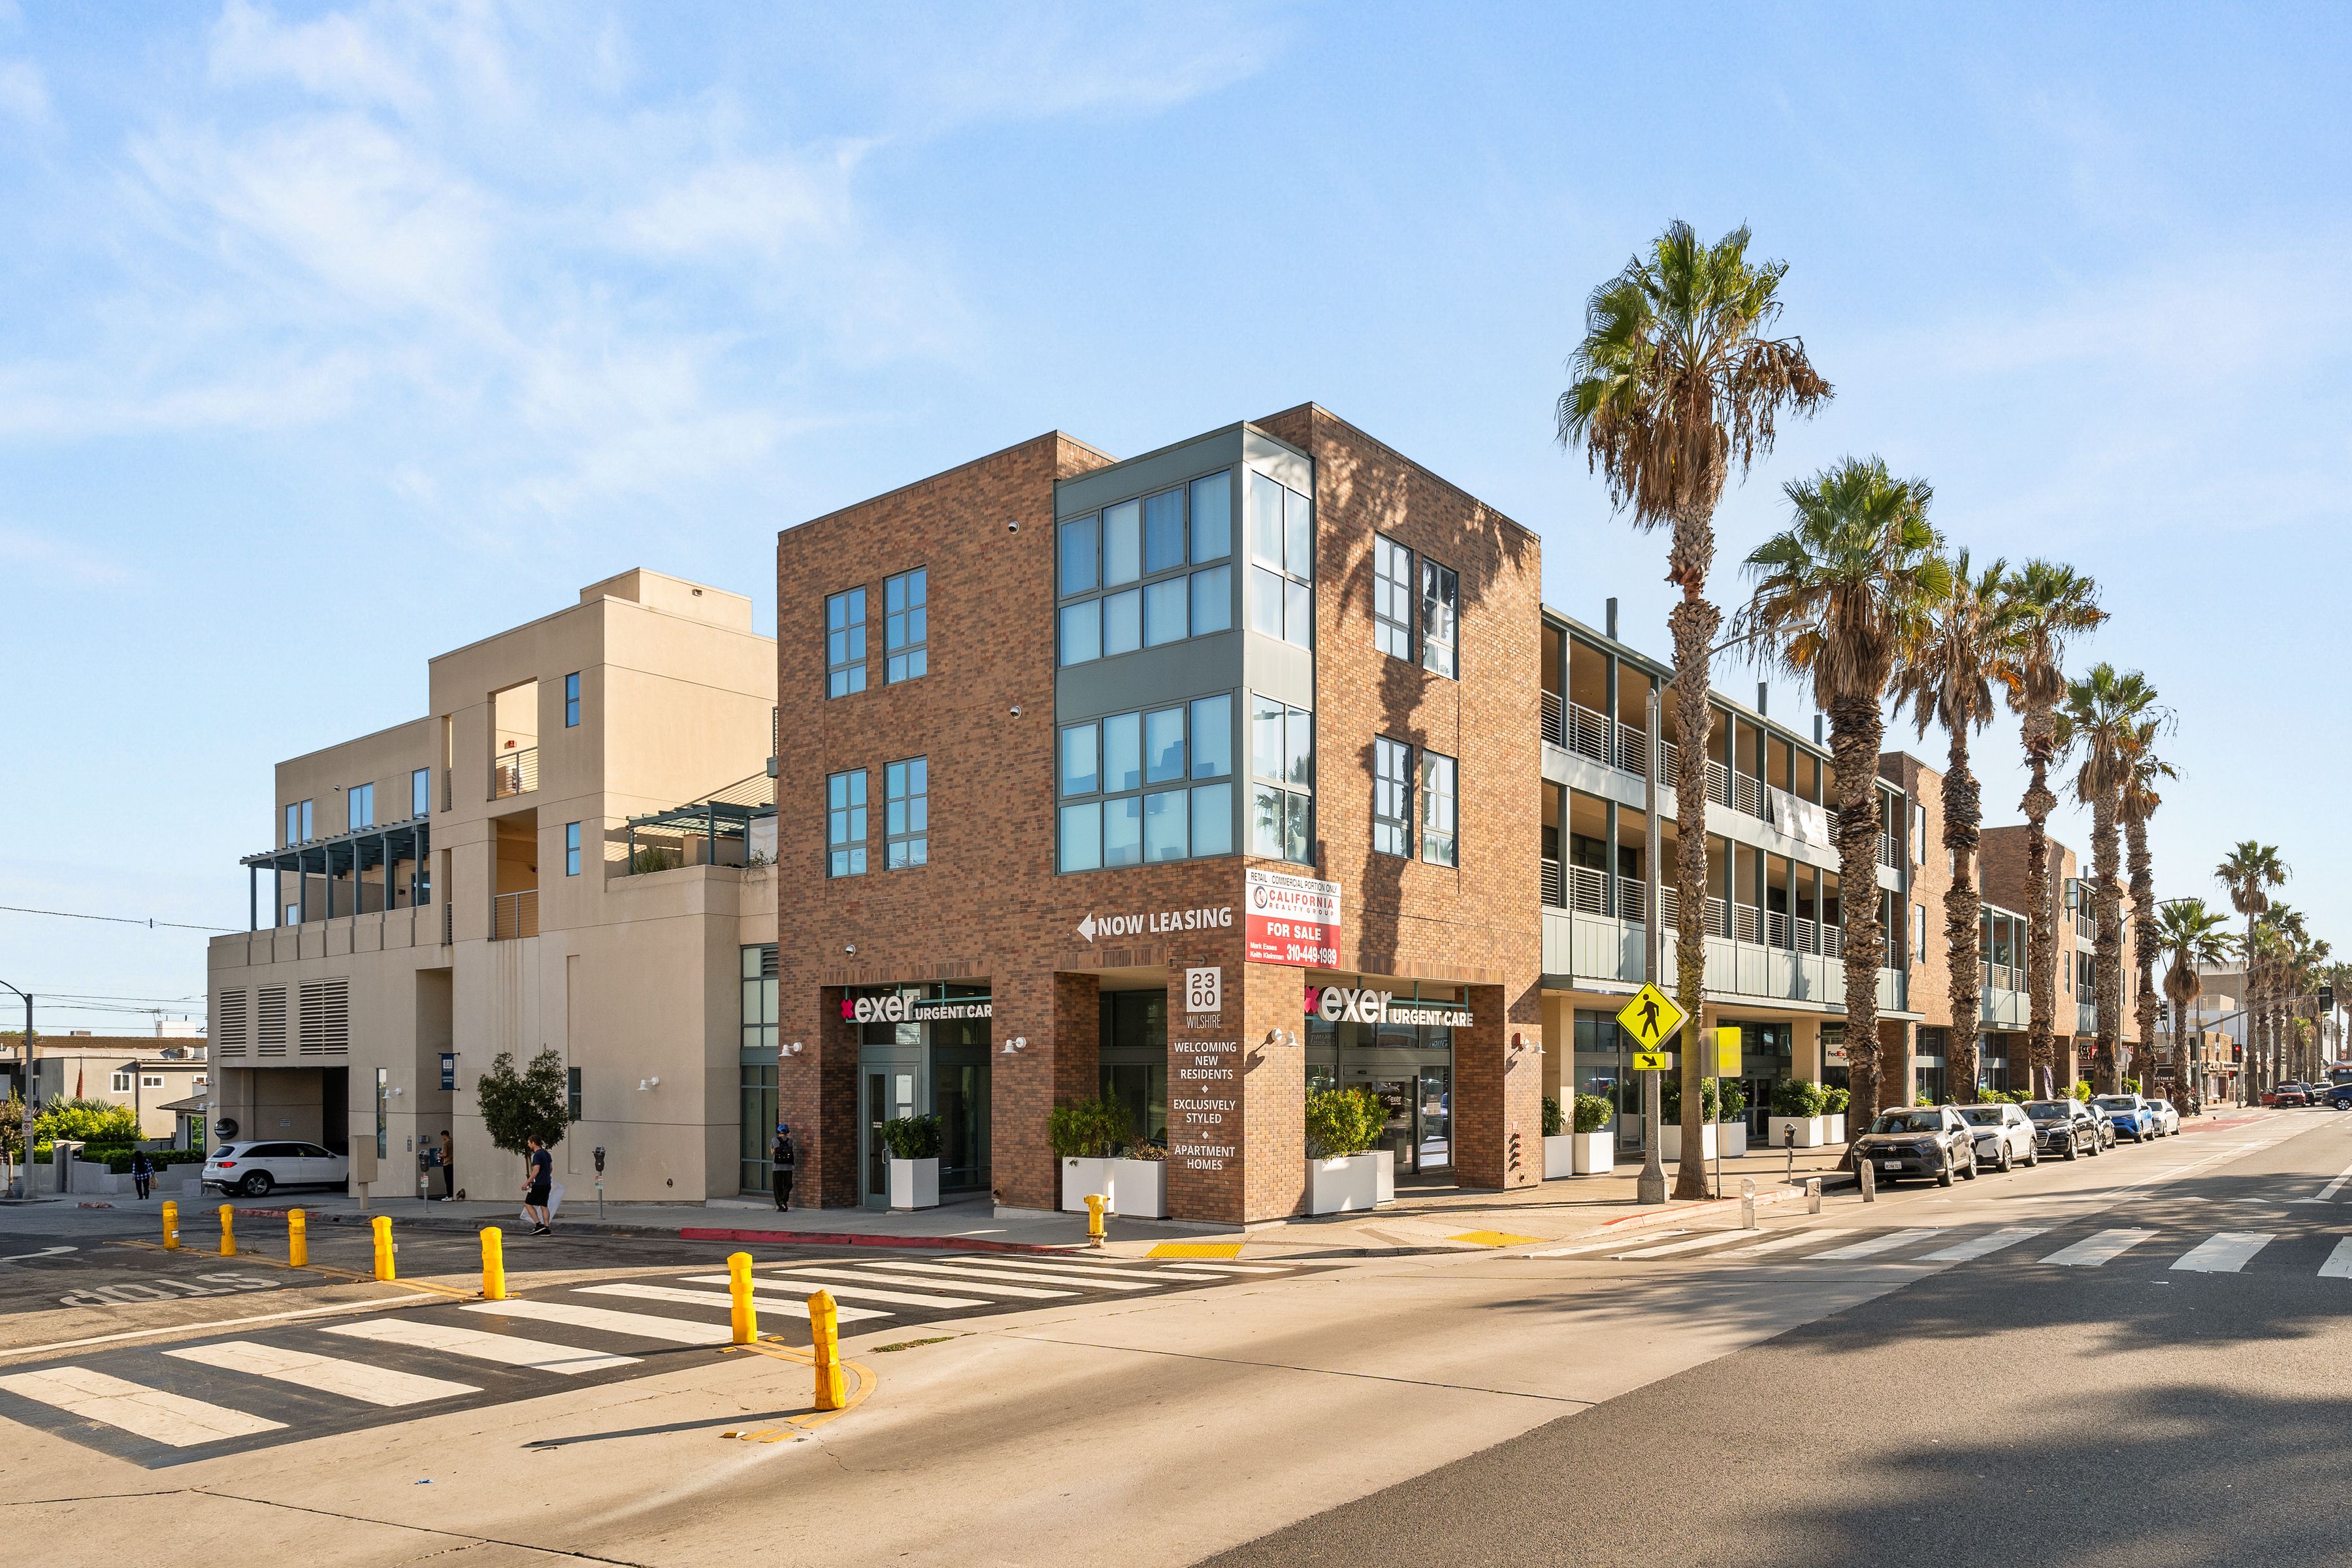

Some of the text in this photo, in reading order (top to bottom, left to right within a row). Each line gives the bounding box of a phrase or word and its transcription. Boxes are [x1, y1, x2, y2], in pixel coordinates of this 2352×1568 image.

[1250, 872, 1337, 894] RETAIL COMMERCIAL PORTION ONLY
[1269, 889, 1333, 909] CALIFORNIA
[1269, 902, 1334, 917] REALTY GROUP
[1098, 906, 1232, 936] NOW LEASING
[1267, 921, 1322, 941] FOR SALE
[1263, 943, 1277, 951] Esses
[1286, 943, 1337, 965] 310-449-1989
[1263, 952, 1284, 960] Kleinman
[1192, 973, 1215, 989] 23
[1192, 990, 1215, 1007] 00
[1320, 986, 1392, 1024] exer
[855, 995, 915, 1024] exer
[915, 1004, 992, 1021] URGENT CAR
[1392, 1008, 1473, 1027] URGENT CARE
[1186, 1014, 1222, 1029] WILSHIRE
[1174, 1042, 1237, 1053] WELCOMING
[1195, 1055, 1218, 1066] NEW
[1180, 1069, 1233, 1080] RESIDENTS
[1173, 1099, 1236, 1111] EXCLUSIVELY
[1186, 1113, 1222, 1124] STYLED
[1174, 1145, 1235, 1157] APARTMENT
[1186, 1158, 1223, 1171] HOMES
[59, 1273, 282, 1307] STOP
